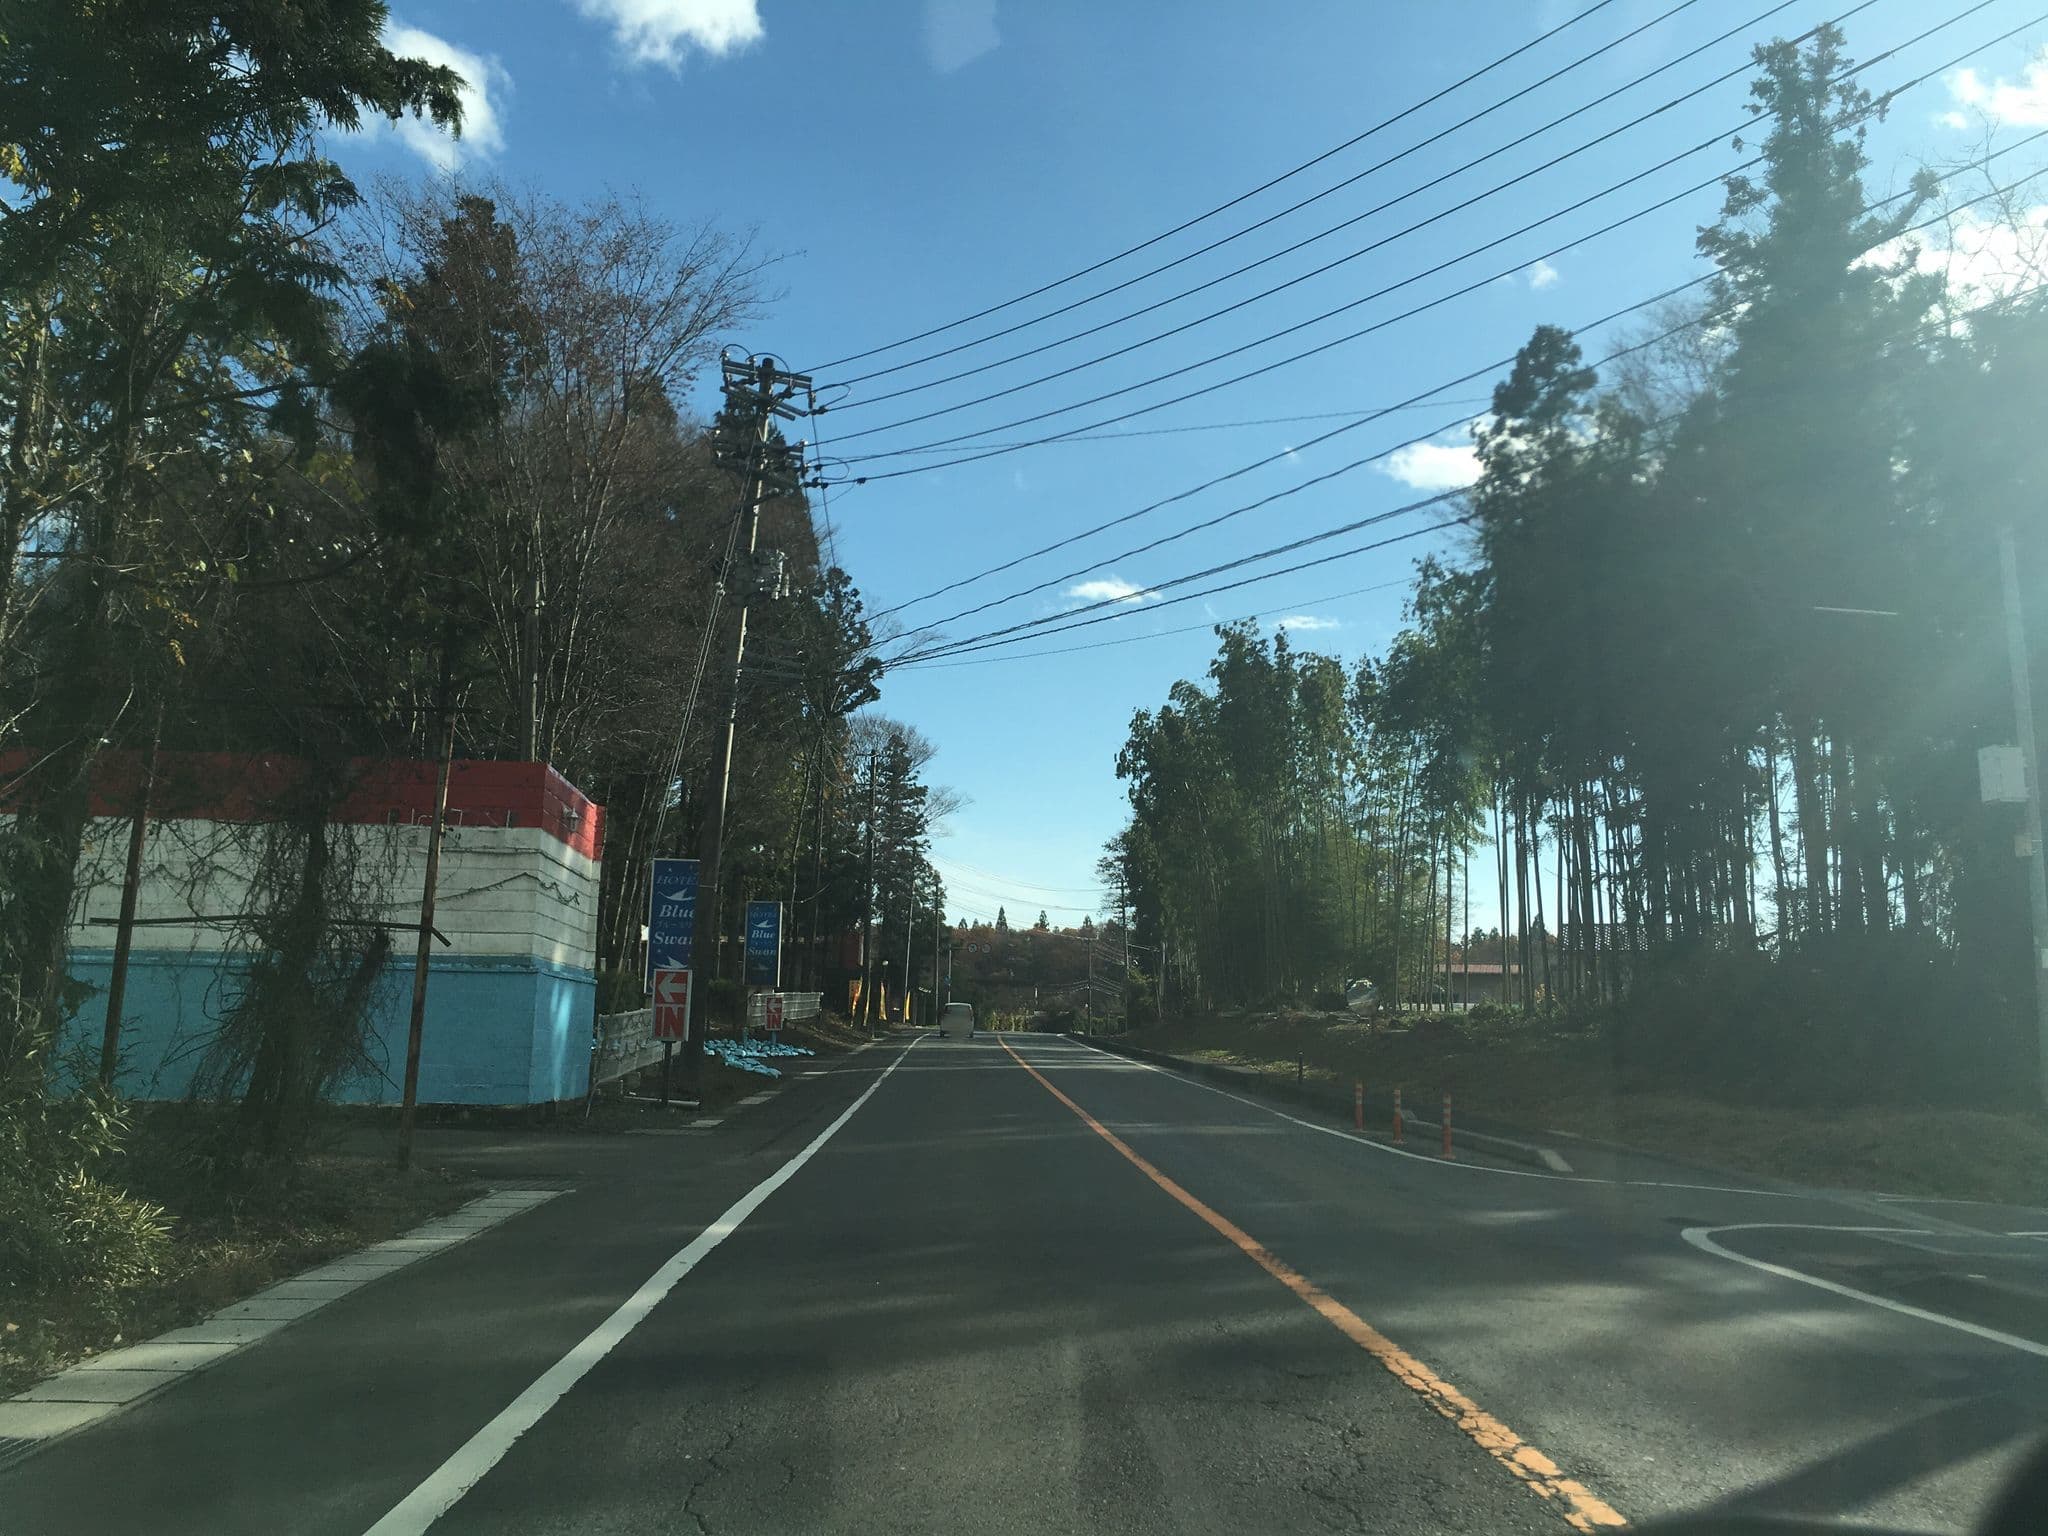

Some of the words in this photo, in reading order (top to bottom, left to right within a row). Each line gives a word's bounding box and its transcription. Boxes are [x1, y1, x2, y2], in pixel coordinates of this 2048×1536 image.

[751, 930, 776, 938] Blue
[655, 1006, 685, 1039] IN
[767, 1014, 781, 1029] IN
